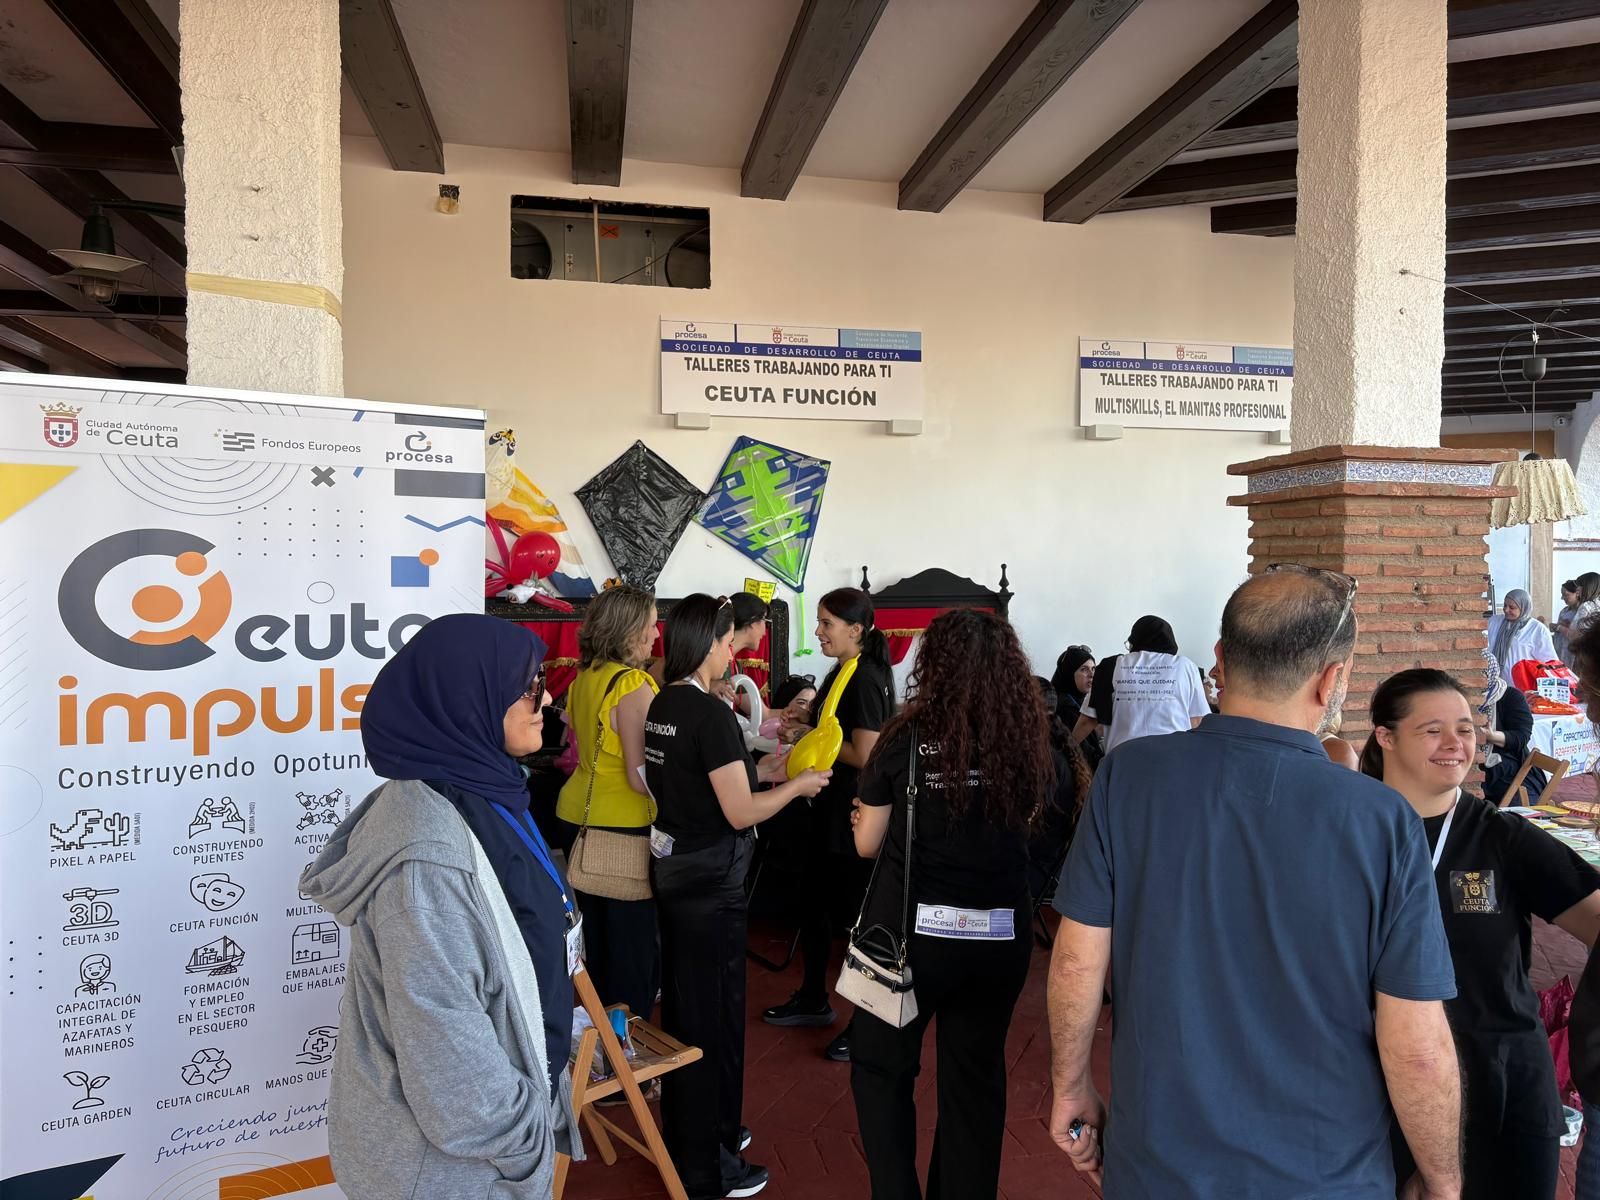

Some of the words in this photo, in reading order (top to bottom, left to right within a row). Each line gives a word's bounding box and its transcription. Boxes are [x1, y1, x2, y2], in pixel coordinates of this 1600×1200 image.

[675, 332, 708, 340] procesa
[674, 343, 731, 353] SOCIEDAD
[744, 346, 758, 354] DE
[767, 347, 837, 358] DESARROLLO
[845, 350, 858, 358] DE
[867, 351, 900, 360] CEUTA
[1092, 349, 1121, 357] procesa
[684, 357, 750, 373] TALLERES
[754, 360, 840, 377] TRABAJANDO
[844, 363, 876, 378] PARA
[880, 365, 892, 378] TI
[1092, 360, 1141, 369] SOCIEDAD
[1152, 362, 1164, 370] DE
[1172, 363, 1231, 373] DESARROLLO
[1239, 366, 1250, 374] DE
[1257, 367, 1286, 375] CEUTA
[1100, 372, 1157, 387] TALLERES
[1160, 375, 1234, 390] TRABAJANDO
[1237, 378, 1265, 392] PARA
[1267, 379, 1278, 392] TI
[704, 385, 776, 403] CEUTA
[783, 387, 877, 406] FUNCIÓN
[1095, 397, 1162, 418] MULTISKILLS,
[1165, 400, 1177, 415] EL
[1179, 401, 1221, 417] MANITAS
[1224, 402, 1287, 420] PROFESIONAL
[86, 419, 122, 429] Ciudad
[126, 422, 178, 433] Autónoma
[106, 430, 178, 448] Ceuta
[261, 438, 305, 450] Fondos
[308, 441, 361, 453] Europeos
[385, 450, 453, 463] procesa
[58, 668, 373, 756] impuls
[58, 756, 255, 790] Construyendo
[273, 752, 369, 778] Opotuni
[172, 838, 264, 856] CONSTRUYENDO
[49, 856, 83, 868] PIXEL
[87, 855, 96, 865] A
[99, 851, 137, 864] PAPEL
[193, 851, 245, 865] PUENTES
[286, 904, 326, 917] MULTIS
[1459, 904, 1495, 912] FUNCIÓN
[169, 920, 205, 933] CEUTA
[209, 912, 259, 929] FUNCIÓN
[921, 916, 954, 929] procesa
[62, 934, 100, 947] CEUTA
[104, 931, 120, 943] 3D
[286, 962, 346, 980] EMBALAJES
[183, 977, 250, 996] FORMACIÓN
[282, 982, 303, 994] QUE
[55, 993, 142, 1015] CAPACITACIÓN
[189, 998, 197, 1008] Y
[199, 991, 245, 1007] EMPLEO
[58, 1012, 117, 1029] INTEGRAL
[121, 1008, 137, 1020] DE
[178, 1013, 194, 1025] EN
[197, 1010, 210, 1021] EL
[212, 1003, 256, 1019] SECTOR
[62, 1026, 121, 1043] AZAFATAS
[125, 1023, 133, 1034] Y
[189, 1018, 248, 1037] PESQUERO
[64, 1036, 135, 1057] MARINEROS
[265, 1074, 303, 1090] MANOS
[306, 1069, 328, 1081] QUE
[155, 1095, 192, 1110] CEUTA
[195, 1084, 251, 1104] CIRCULAR
[41, 1118, 80, 1133] CEUTA
[83, 1105, 132, 1125] GARDEN
[170, 1110, 277, 1142] Creciendo
[284, 1098, 328, 1122] junt
[154, 1138, 226, 1164] futuro
[234, 1129, 260, 1143] de
[269, 1115, 328, 1137] nuestr
